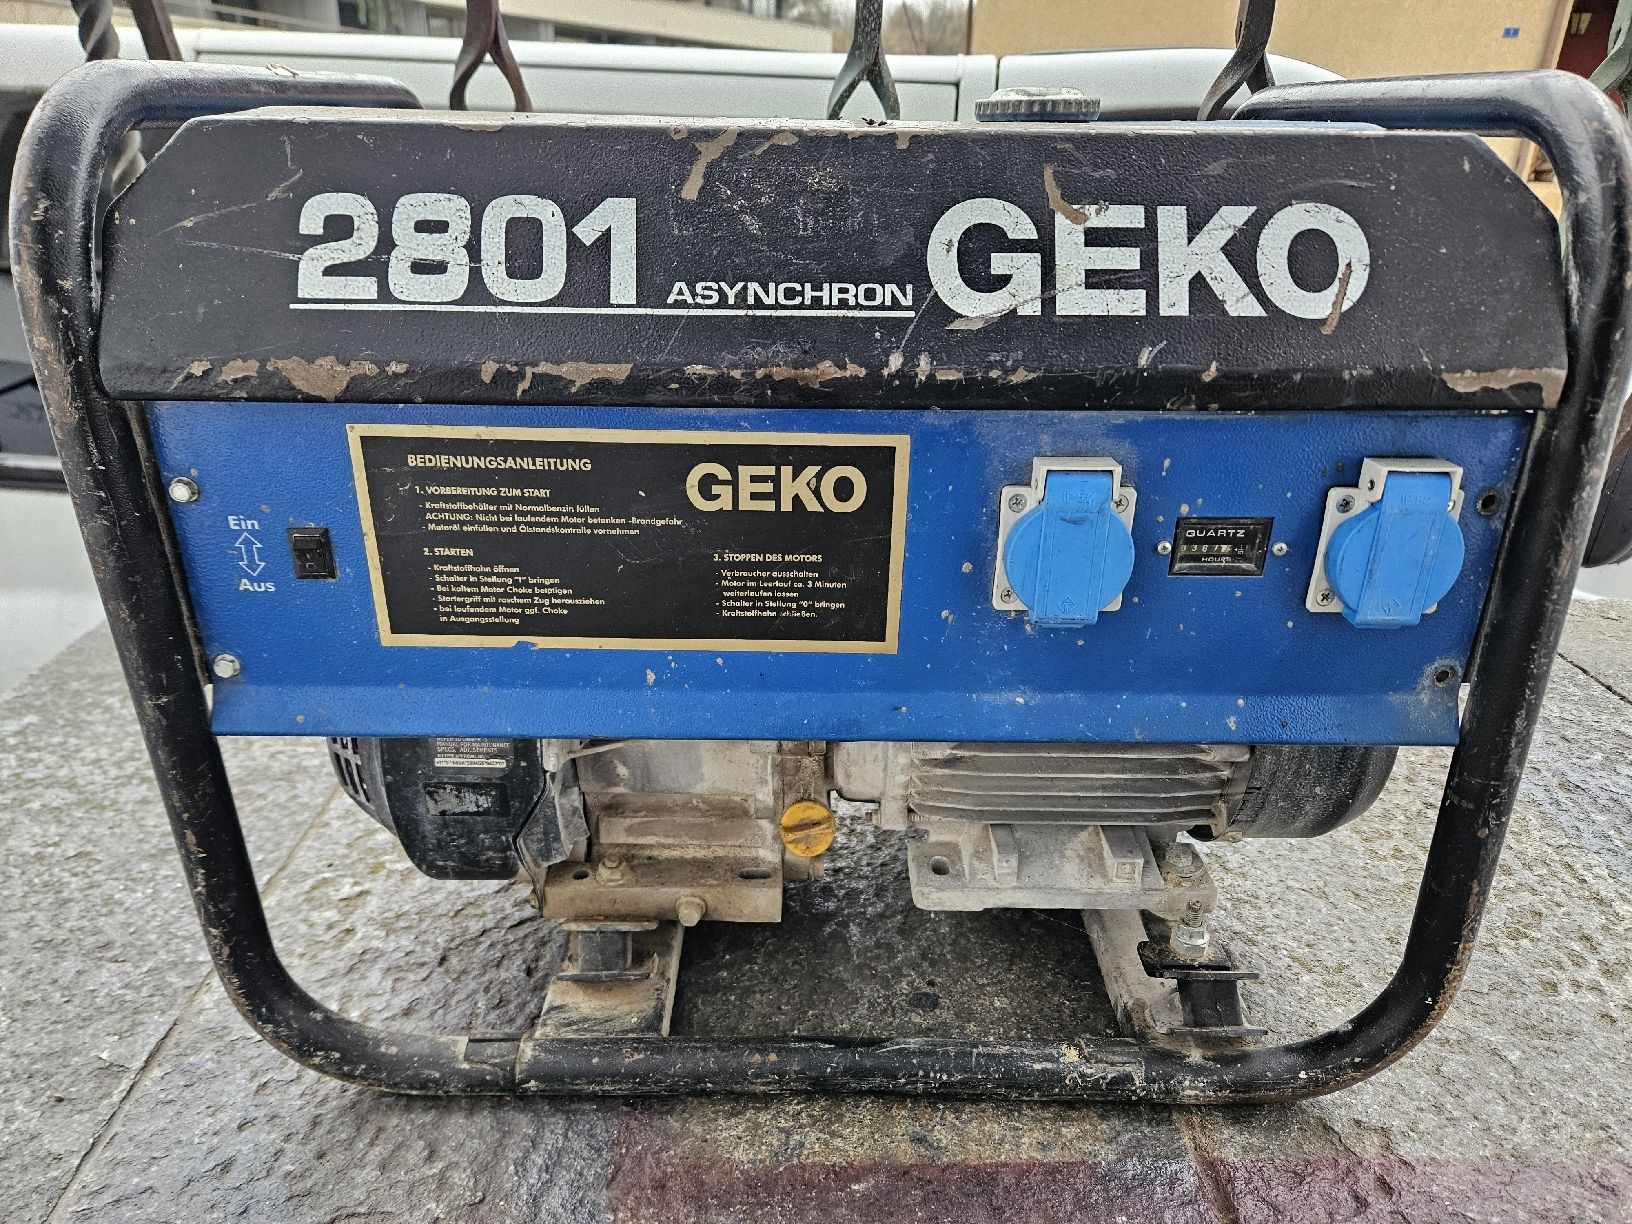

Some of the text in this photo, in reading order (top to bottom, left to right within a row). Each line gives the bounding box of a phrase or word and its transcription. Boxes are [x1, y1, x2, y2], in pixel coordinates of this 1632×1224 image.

[298, 192, 636, 304] 2801
[927, 198, 1370, 319] GEKO
[666, 281, 913, 306] ASYNCHRON
[408, 455, 592, 471] BEDIENUNGSANLEITUNG
[415, 486, 550, 497] 1. VORBEREITUNG ZUM START
[686, 462, 867, 512] GEKO
[425, 502, 599, 513] Kraftstoffbehälter mit Normalbenzin füllen
[228, 516, 259, 529] Ein
[425, 513, 473, 521] ACHTUNG:
[499, 514, 513, 522] bei
[515, 515, 558, 523] laufendem
[588, 516, 625, 524] betanken
[428, 523, 460, 531] Motoröl
[462, 524, 498, 532] einfüllen
[519, 524, 591, 534] Ölstandskontrolle
[423, 548, 473, 557] 2. STARTEN
[724, 554, 763, 562] STOPPEN
[766, 554, 782, 562] DES
[433, 564, 519, 573] Kraftstoffhahn öffnen
[721, 569, 770, 578] Verbraucher
[239, 579, 276, 591] Aus
[479, 575, 512, 584] Stellung
[528, 576, 560, 585] bringen
[814, 581, 847, 589] Minuten
[452, 585, 479, 593] kaltem
[534, 586, 572, 595] betätigen
[438, 595, 481, 603] Startergriff
[498, 596, 531, 604] raschem
[533, 597, 550, 606] Zug
[551, 597, 605, 605] herausziehen
[765, 600, 796, 609] Stellung
[815, 601, 845, 610] bringen
[454, 605, 497, 613] laufendem
[543, 607, 568, 615] Choke
[449, 615, 519, 624] Ausgangsstellung
